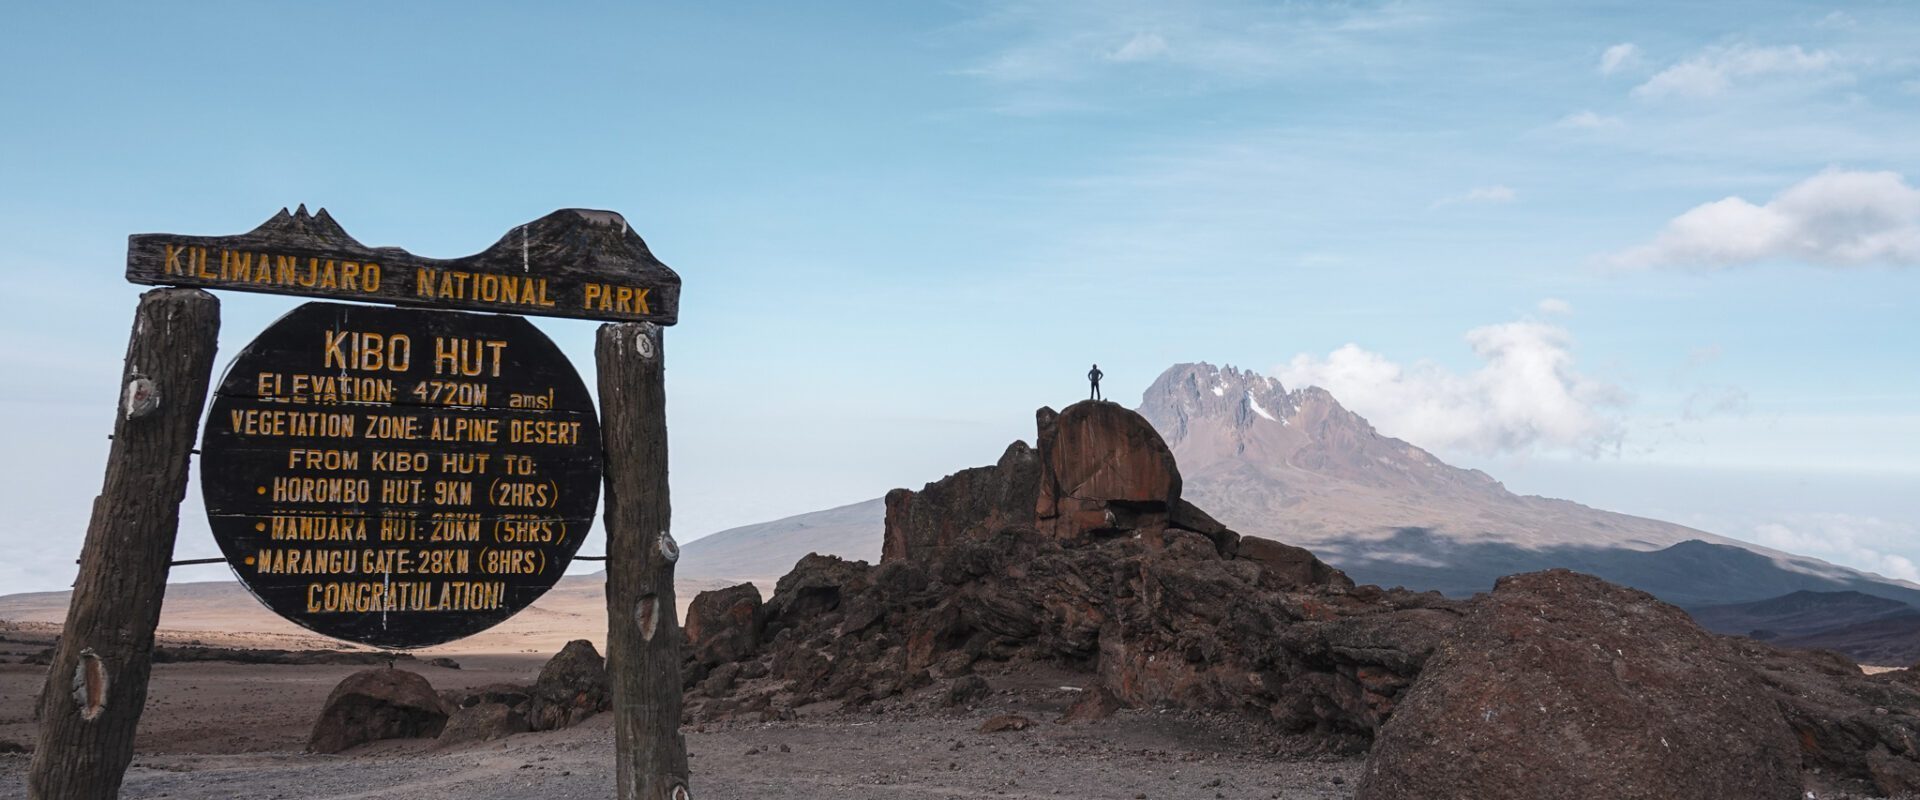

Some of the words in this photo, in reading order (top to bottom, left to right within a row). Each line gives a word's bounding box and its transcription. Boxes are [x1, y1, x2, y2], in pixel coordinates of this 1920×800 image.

[164, 243, 381, 293] KILIMANJARO
[416, 267, 556, 307] NATIONAL
[584, 282, 651, 315] PARK
[324, 329, 411, 372] KIBO
[435, 336, 508, 378] HUT
[257, 372, 398, 407] ELEVATION:
[413, 381, 487, 410] 4720M
[509, 387, 554, 413] amsl
[231, 409, 355, 438] VEGETATION
[364, 414, 424, 441] ZONE:
[431, 417, 499, 443] ALPINE
[510, 420, 581, 445] DESERT
[288, 448, 359, 471] FROM
[371, 450, 429, 473] KIBO
[442, 453, 491, 475] HUT
[503, 455, 538, 476] TO:
[272, 476, 370, 504] HOROMBO
[381, 479, 426, 505] HUT:
[434, 481, 472, 506] 9KM
[489, 478, 559, 509] (2HRS)
[381, 511, 425, 542] HUT:
[430, 512, 481, 543] 20KM
[494, 513, 567, 545] (5HRS)
[257, 549, 357, 575] MARANGU
[362, 549, 416, 575] GATE:
[417, 550, 470, 575] 28KM
[478, 546, 547, 576] (8HRS)
[306, 581, 506, 613] CONGRATULATION!
